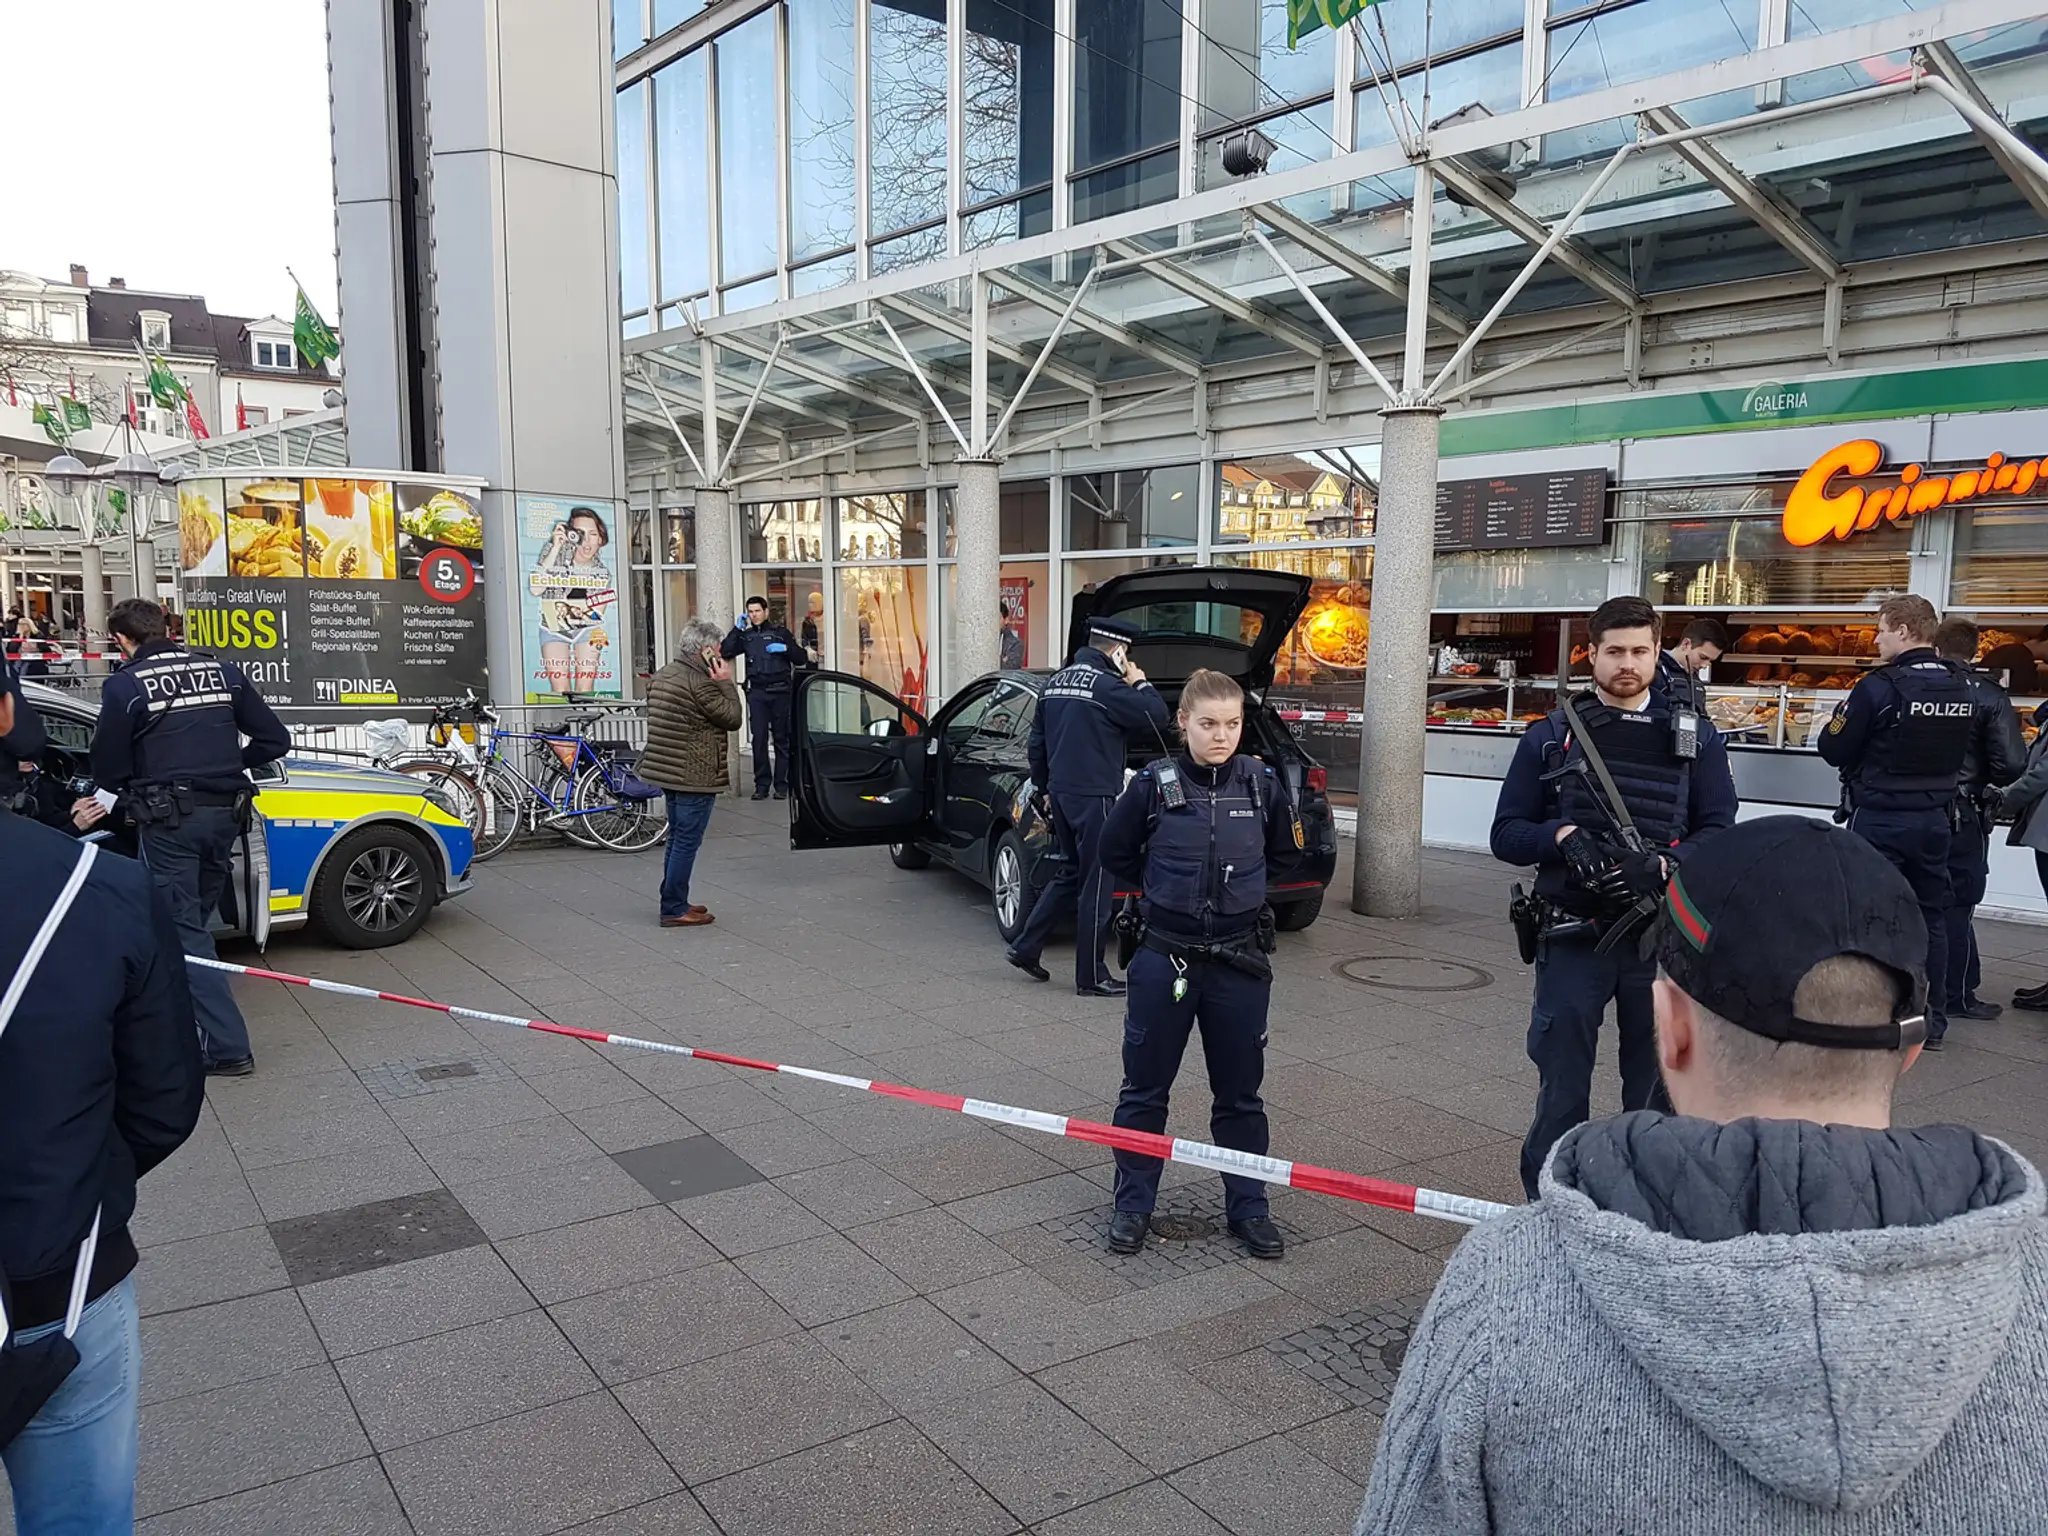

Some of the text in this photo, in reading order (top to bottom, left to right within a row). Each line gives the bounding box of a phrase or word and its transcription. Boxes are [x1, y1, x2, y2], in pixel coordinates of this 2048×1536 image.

[1754, 391, 1808, 411] GALERIA
[437, 560, 460, 581] 5.
[435, 581, 461, 590] Etage
[531, 575, 607, 587] EchteBilder
[226, 588, 254, 603] Great
[255, 589, 287, 603] View!
[309, 602, 357, 613] Salat-Buffet
[402, 605, 455, 615] Wok-Gerichte
[310, 615, 371, 626] Gemüse-Buffet
[403, 630, 433, 640] Kuchen
[440, 631, 464, 640] Torten
[311, 641, 379, 653] Regionale Küche
[404, 642, 433, 652] Frische
[540, 658, 607, 668] Untergeschoss
[533, 671, 612, 680] FOTO-EXPRESS
[1048, 671, 1098, 690] POLIZEI
[143, 670, 228, 700] POLIZEI
[340, 679, 398, 693] DINEA
[278, 694, 293, 704] Uhr
[424, 696, 454, 704] GALERIA
[1910, 702, 1972, 716] POLIZEI
